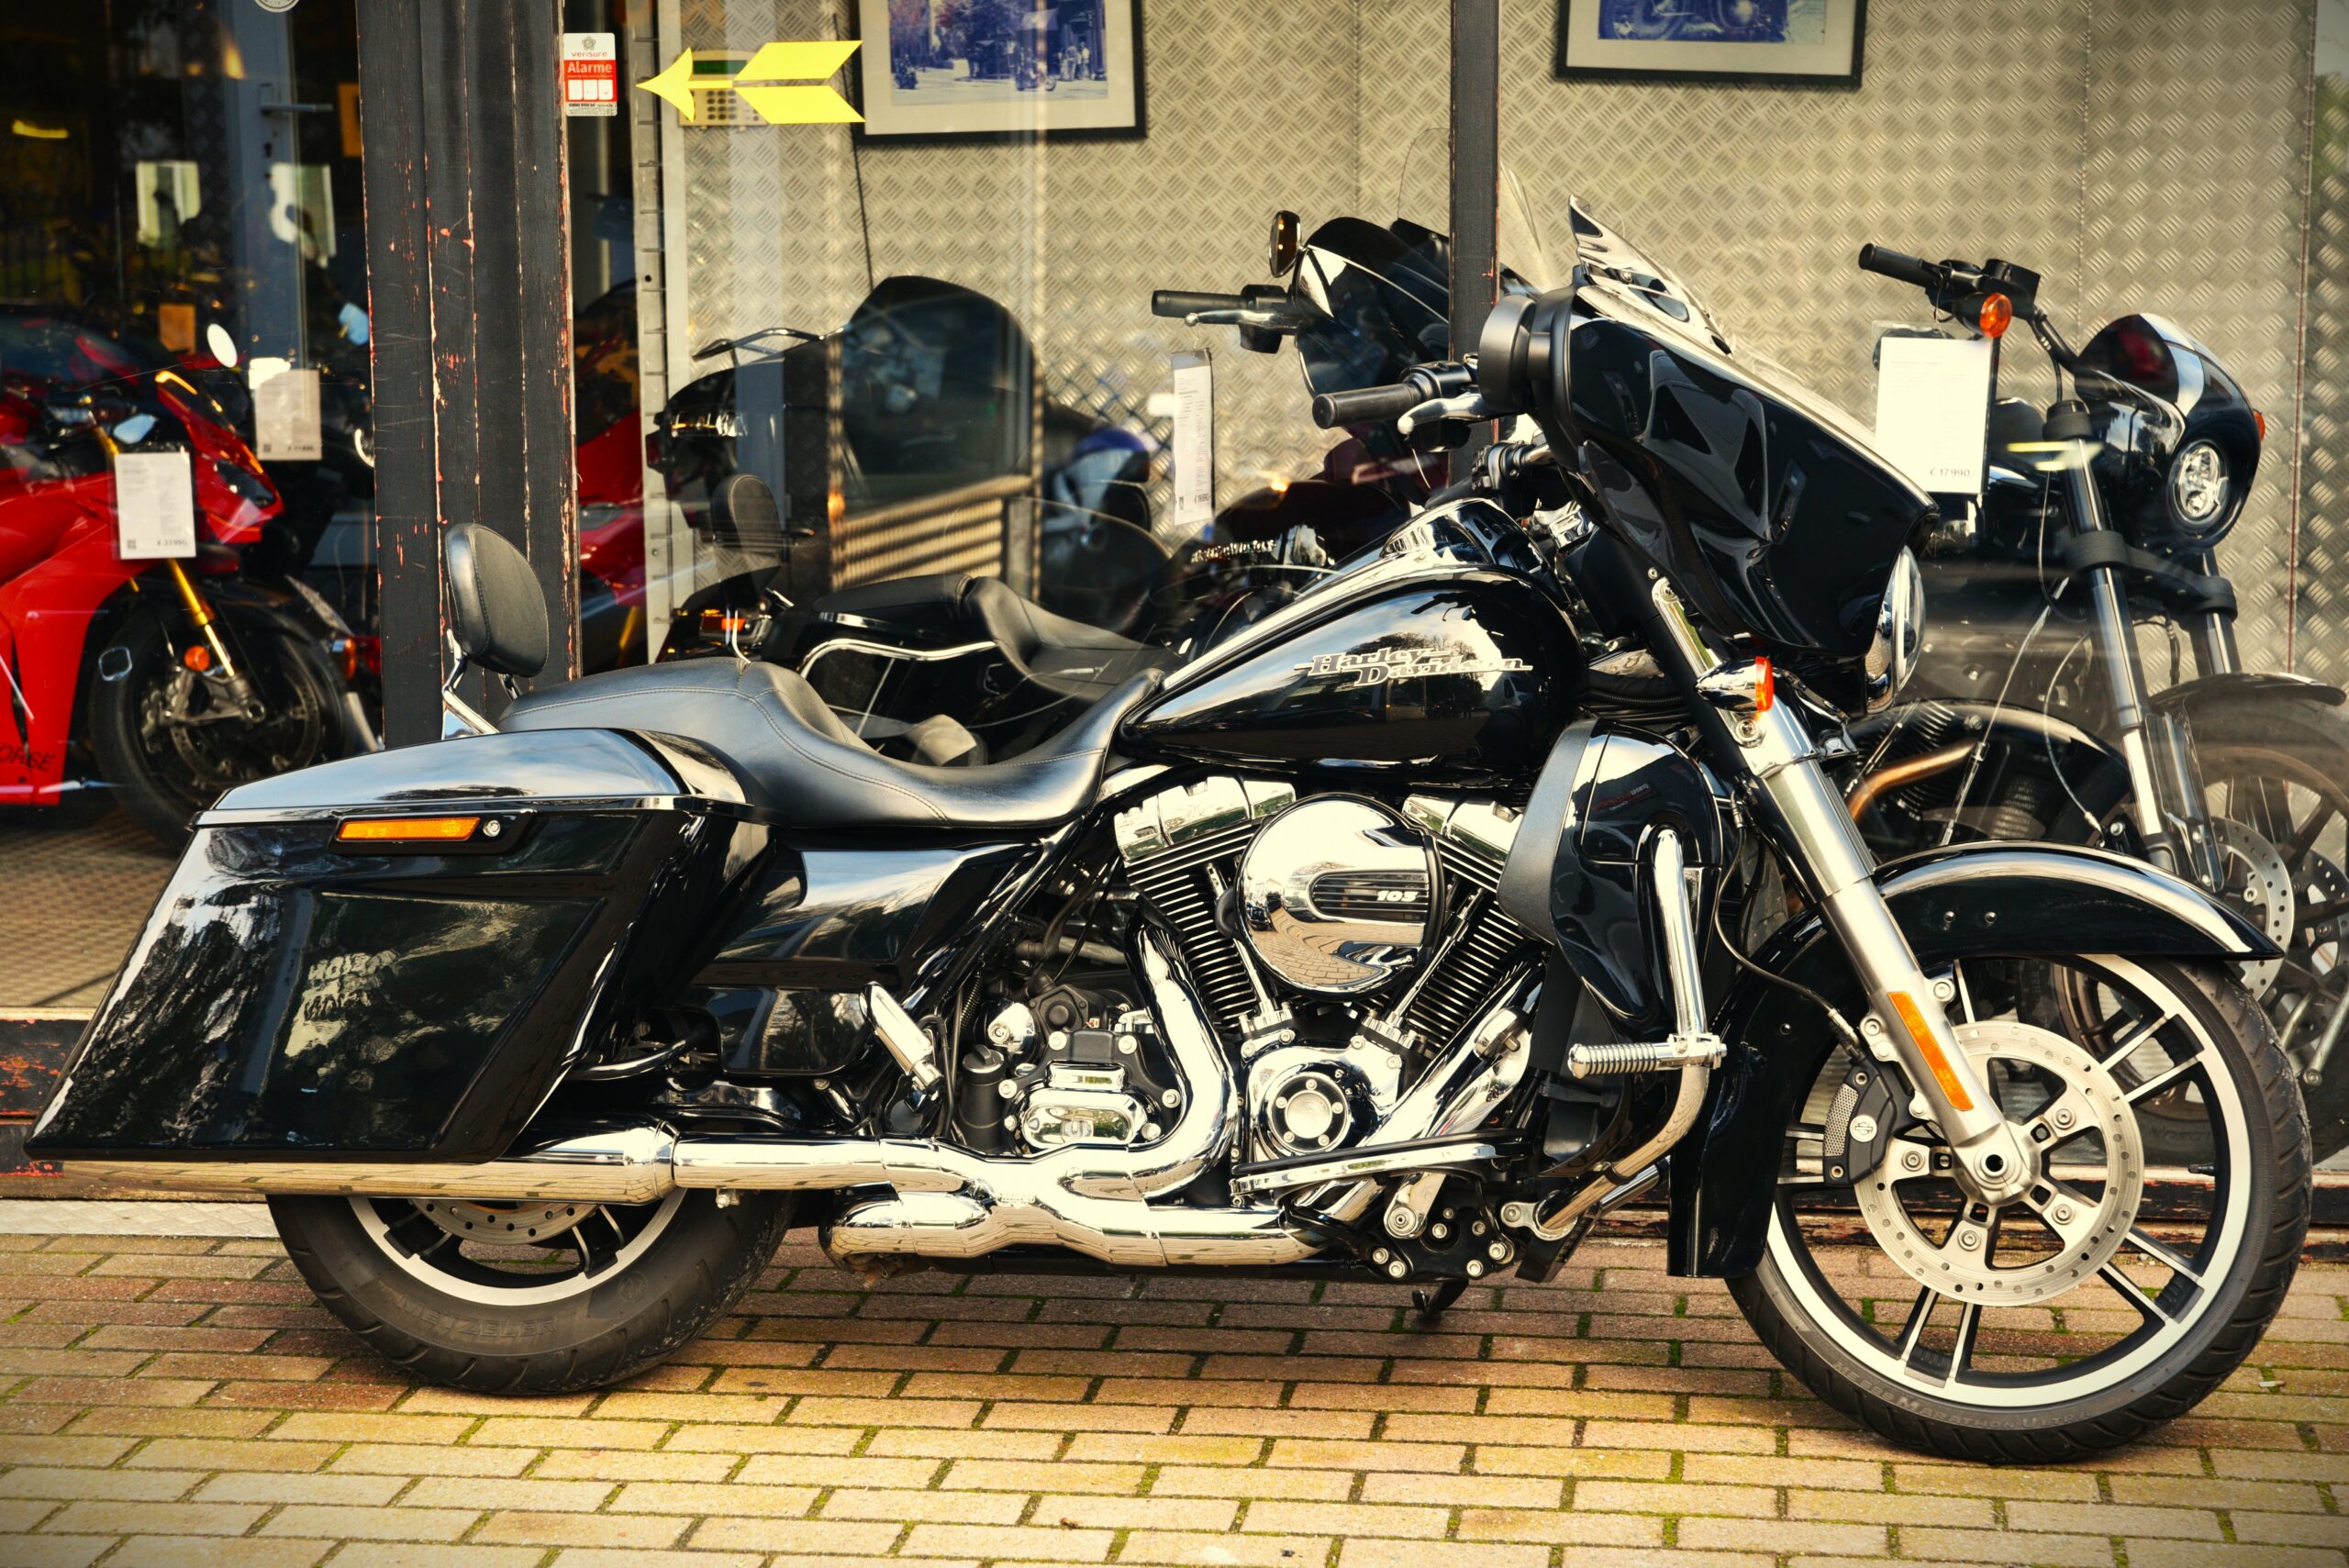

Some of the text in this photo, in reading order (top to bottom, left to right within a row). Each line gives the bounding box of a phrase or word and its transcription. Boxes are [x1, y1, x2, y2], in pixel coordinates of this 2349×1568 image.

[568, 61, 613, 73] Alarme
[1301, 646, 1452, 677] Harley
[1353, 657, 1533, 688] Davidson
[395, 1293, 559, 1338] METZELER
